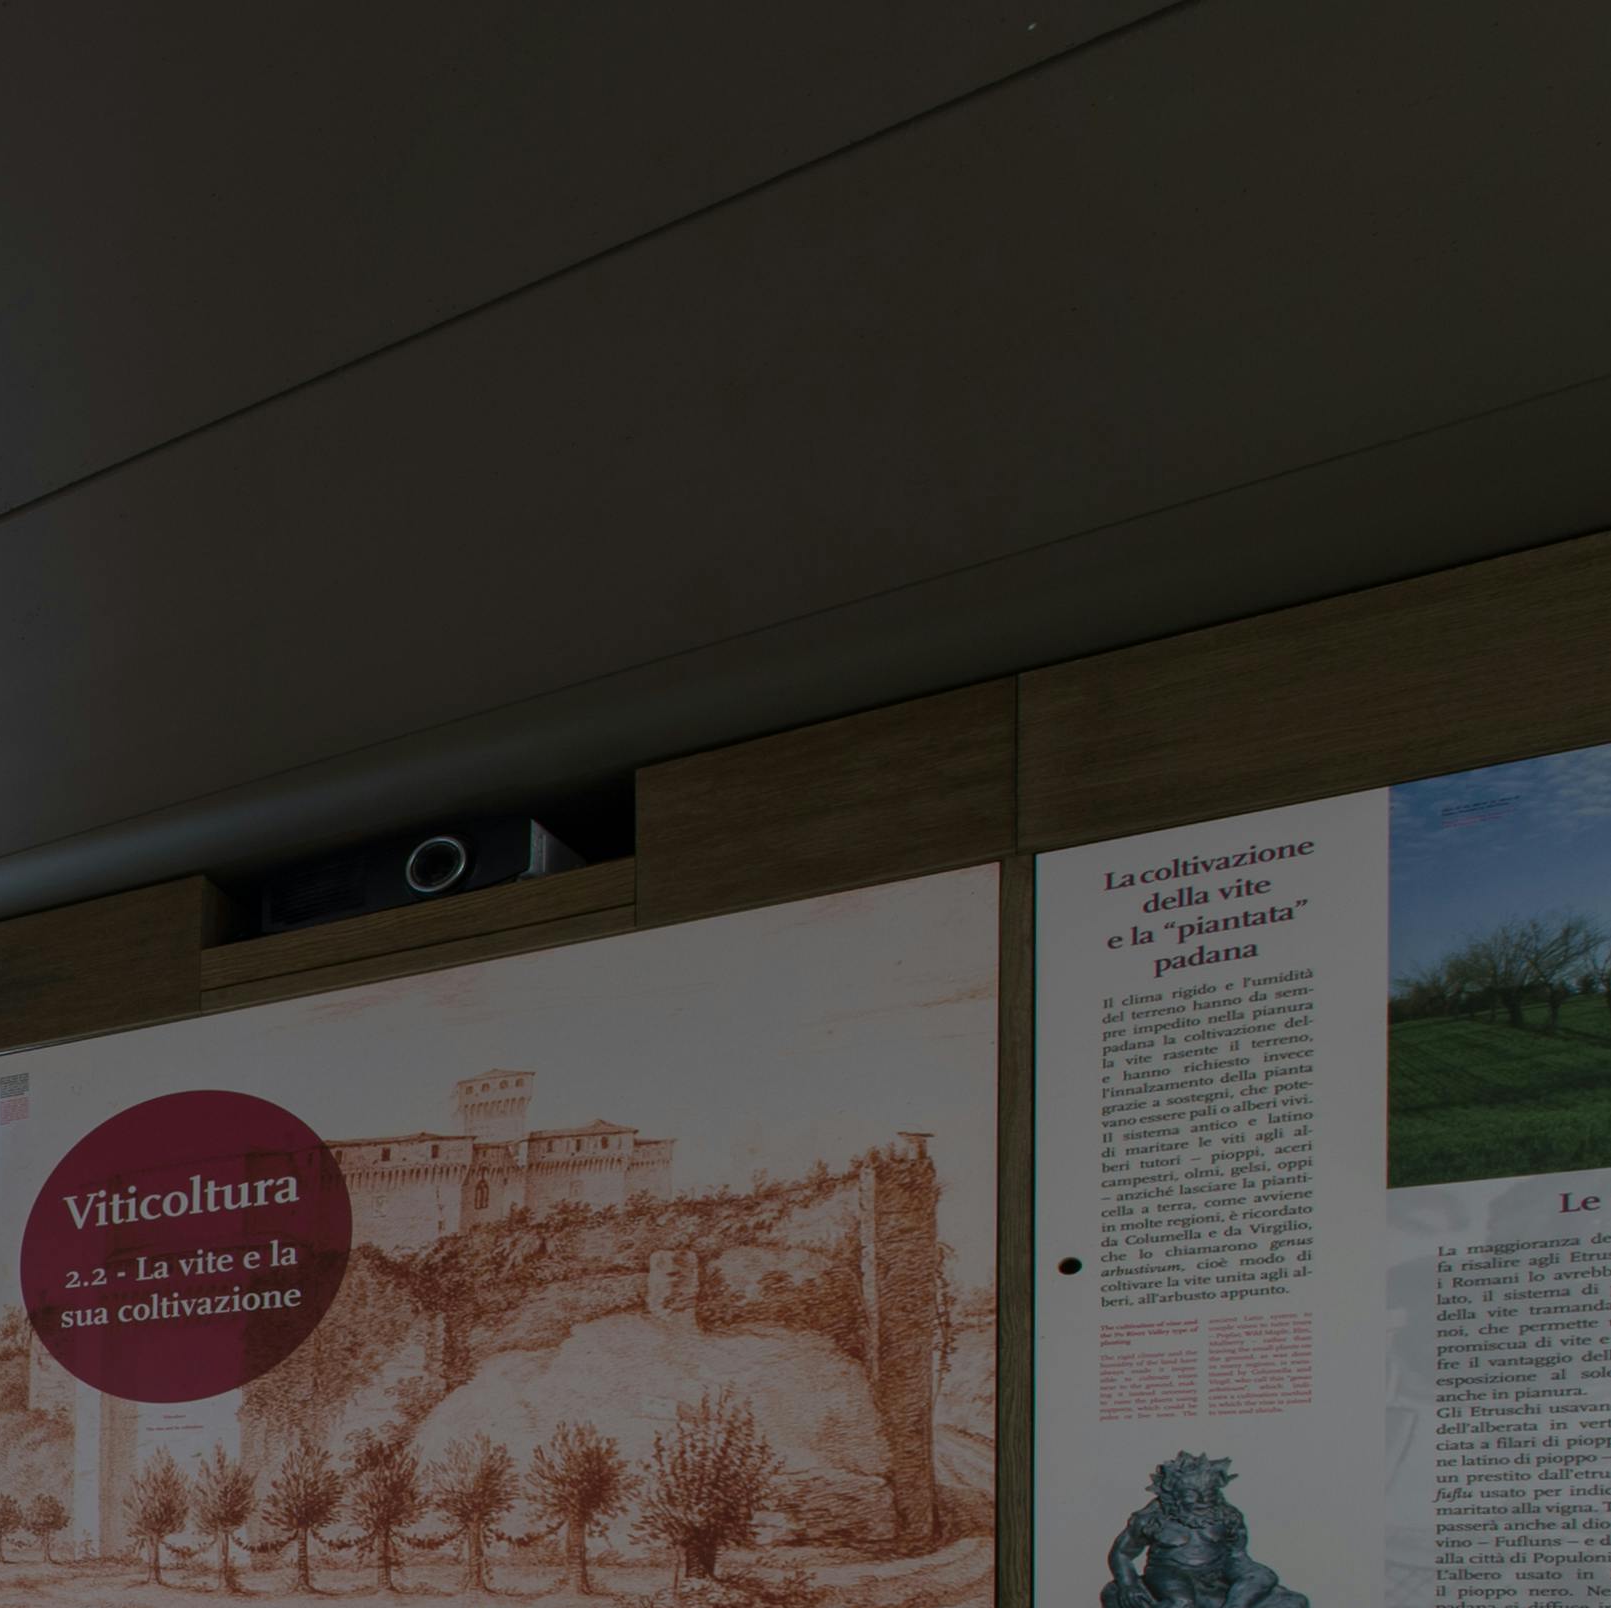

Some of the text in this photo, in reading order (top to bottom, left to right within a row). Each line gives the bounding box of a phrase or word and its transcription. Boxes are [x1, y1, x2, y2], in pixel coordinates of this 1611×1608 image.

[1104, 841, 1314, 890] La coltivazione
[1142, 878, 1271, 913] della vite
[1130, 925, 1154, 945] la
[1154, 943, 1258, 978] padana
[1101, 986, 1314, 1024] del terreno hanno da sem-
[1103, 996, 1114, 1009] Il
[1121, 993, 1162, 1006] clima
[1171, 983, 1216, 1000] rigido
[1101, 1001, 1313, 1042] pre impedito nella pianura
[62, 1174, 299, 1229] Viticoltura
[1559, 1192, 1600, 1213] Le
[64, 1267, 107, 1288] 2.2
[135, 1256, 169, 1281] La
[178, 1248, 233, 1276] vite
[269, 1239, 297, 1266] la
[60, 1285, 301, 1328] sua coltivazione
[1434, 1386, 1587, 1402] anche in pianura.
[1435, 1501, 1599, 1516] maritato alla vigna.
